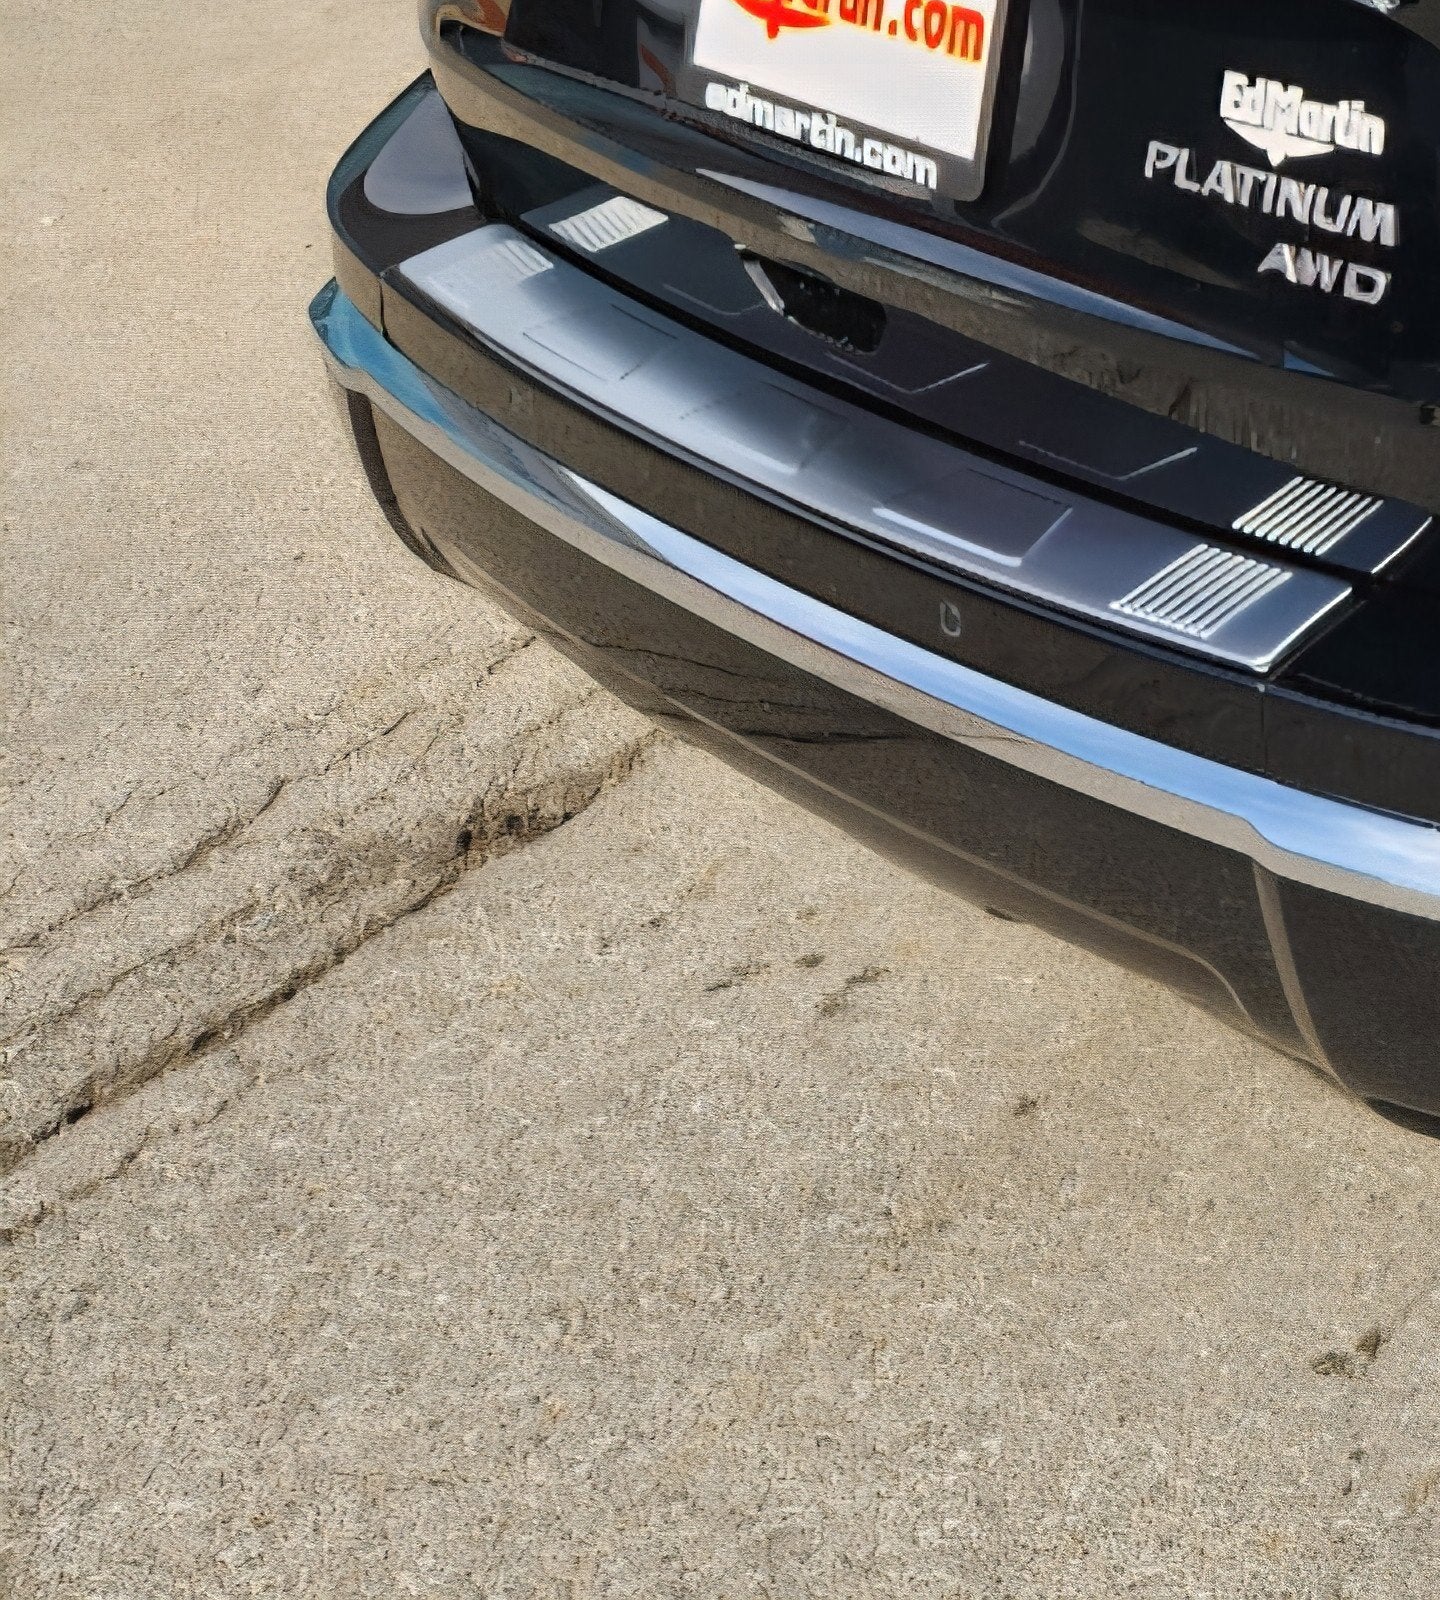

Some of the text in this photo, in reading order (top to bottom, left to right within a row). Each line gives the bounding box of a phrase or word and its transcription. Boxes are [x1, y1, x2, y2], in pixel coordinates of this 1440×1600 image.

[705, 81, 938, 191] edmartin.com
[1220, 69, 1386, 157] EdMartin
[1144, 140, 1399, 247] PLATINUM
[1257, 242, 1392, 304] AWD
